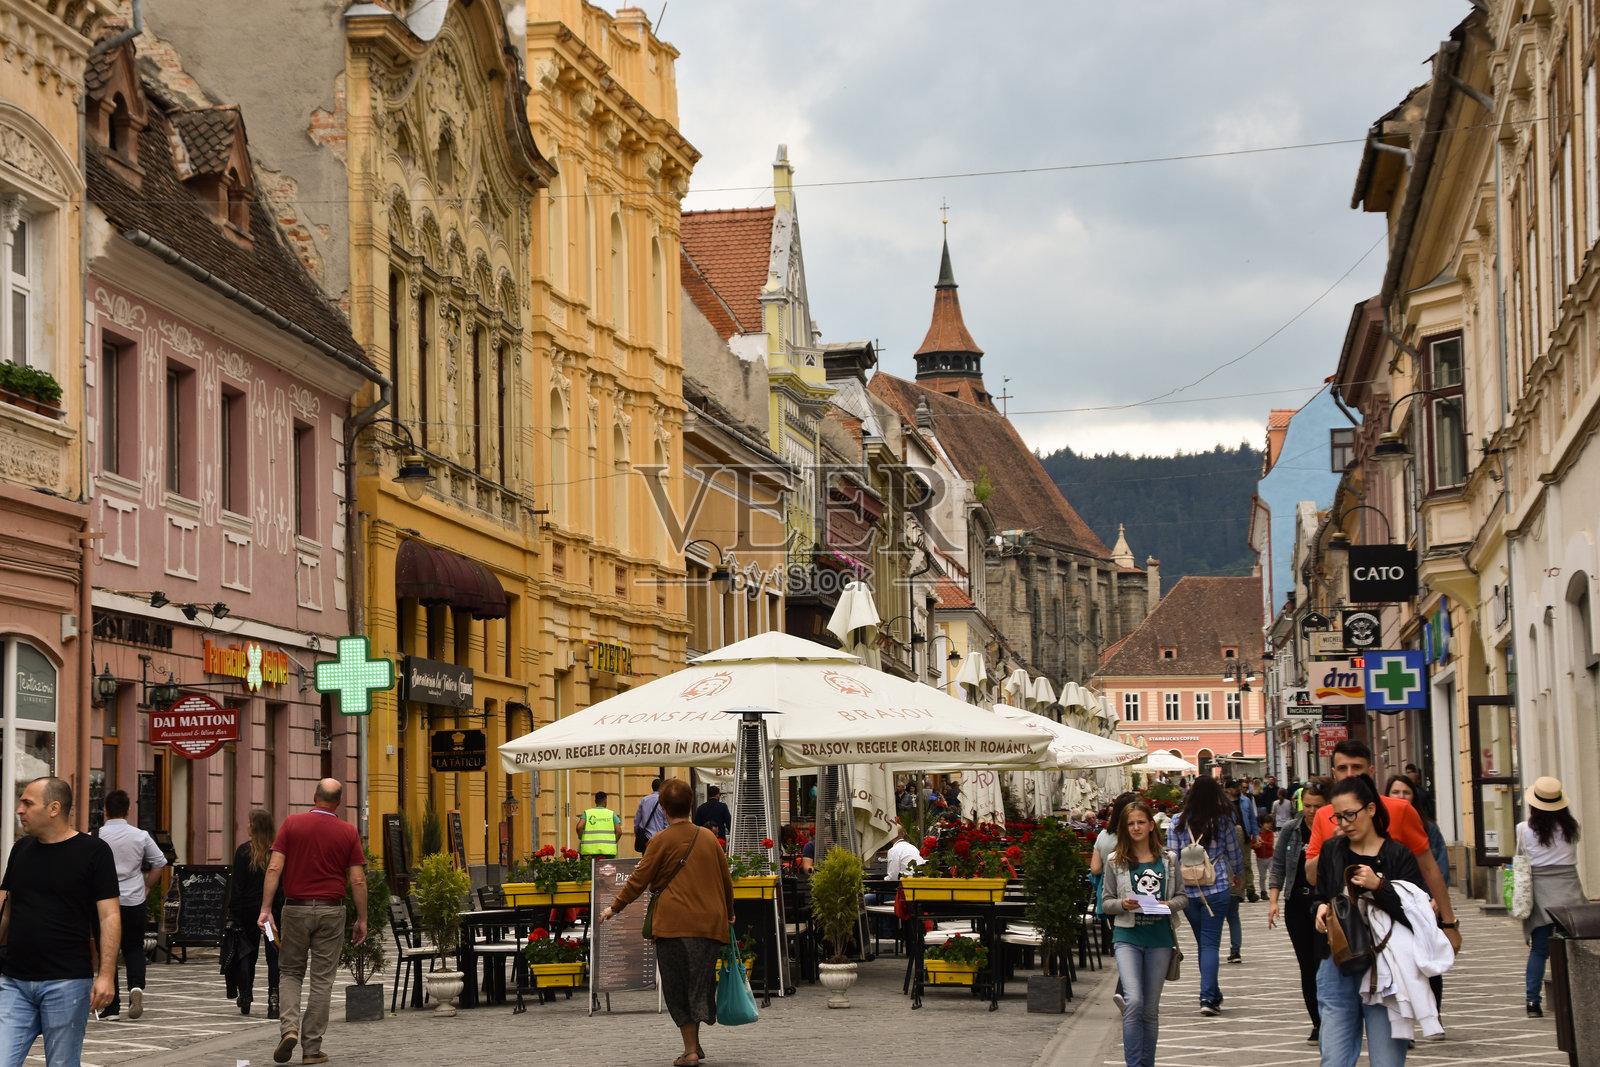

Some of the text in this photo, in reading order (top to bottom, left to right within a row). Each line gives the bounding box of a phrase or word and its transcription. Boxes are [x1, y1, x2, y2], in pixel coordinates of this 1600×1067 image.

[1353, 566, 1405, 581] CATO
[597, 641, 633, 676] PIETRA
[17, 671, 54, 694] Tentazioni
[1323, 667, 1358, 688] dm
[153, 714, 235, 729] DAI MATTONI
[593, 711, 739, 726] KRONSTADT
[161, 730, 194, 738] Restaurant
[565, 743, 606, 759] REGELE
[609, 741, 671, 758] ORAȘELOR
[675, 739, 688, 755] ÎN
[856, 740, 898, 754] REGELE
[901, 739, 961, 755] ORAȘELOR
[964, 737, 976, 752] ÎN
[436, 759, 448, 768] LA
